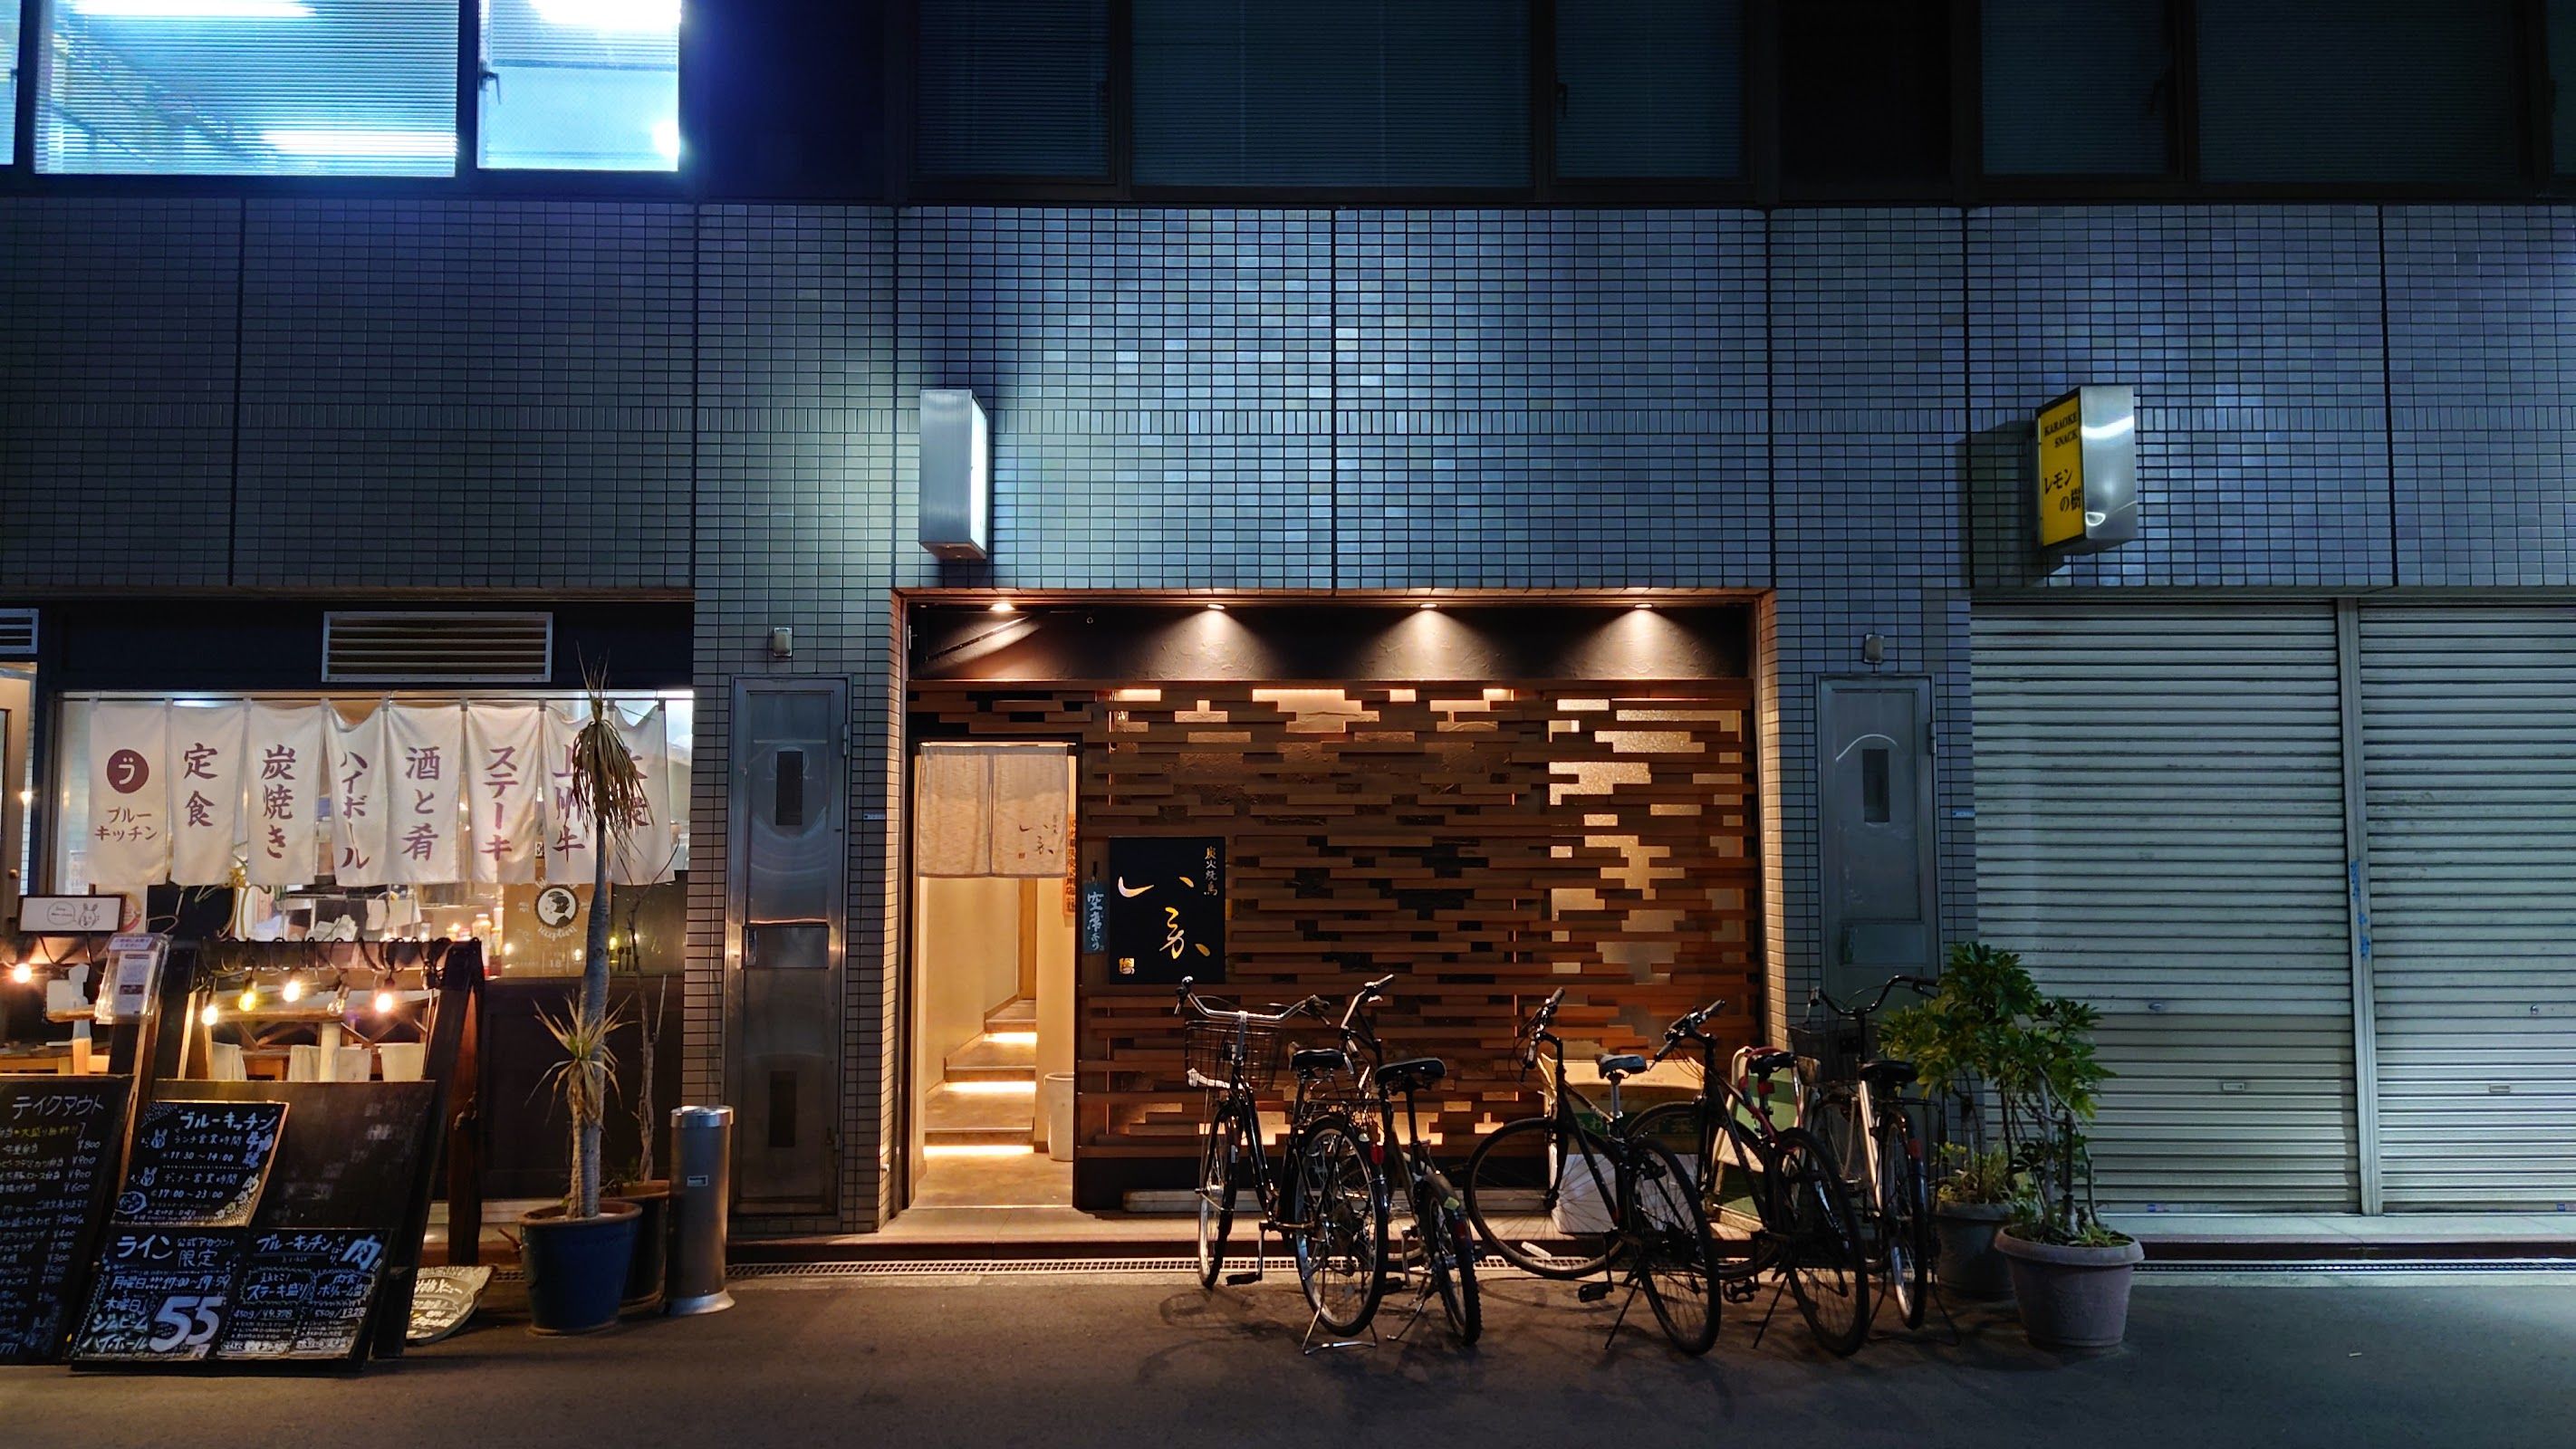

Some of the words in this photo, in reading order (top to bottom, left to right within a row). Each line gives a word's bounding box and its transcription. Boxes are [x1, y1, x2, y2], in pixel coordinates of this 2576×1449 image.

[2044, 411, 2078, 437] KARAOKE
[2054, 428, 2078, 448] SNACK
[2044, 468, 2072, 494] レモン
[2060, 486, 2081, 513] の樹
[184, 743, 217, 828] 定食
[261, 744, 296, 859] 炭焼き
[340, 752, 370, 869] ハイボール
[401, 746, 441, 861] 酒と肴
[479, 746, 519, 861] ステーキ
[107, 807, 152, 823] ブルー
[94, 825, 158, 841] キッチン
[1204, 846, 1218, 897] 炭火焼鳥
[13, 1094, 104, 1119] テイクアウト
[180, 1111, 277, 1131] ブルーキッチン
[117, 1233, 174, 1260] ライン
[178, 1238, 235, 1248] 公式アカウント
[255, 1233, 332, 1252] ブルーキッチン
[178, 1249, 218, 1268] 限定
[246, 1281, 310, 1301] ステーキ盛り
[103, 1297, 143, 1313] 木曜日
[91, 1313, 149, 1333] ジムビーム
[149, 1295, 227, 1353] 55
[82, 1332, 149, 1353] ハイボール
